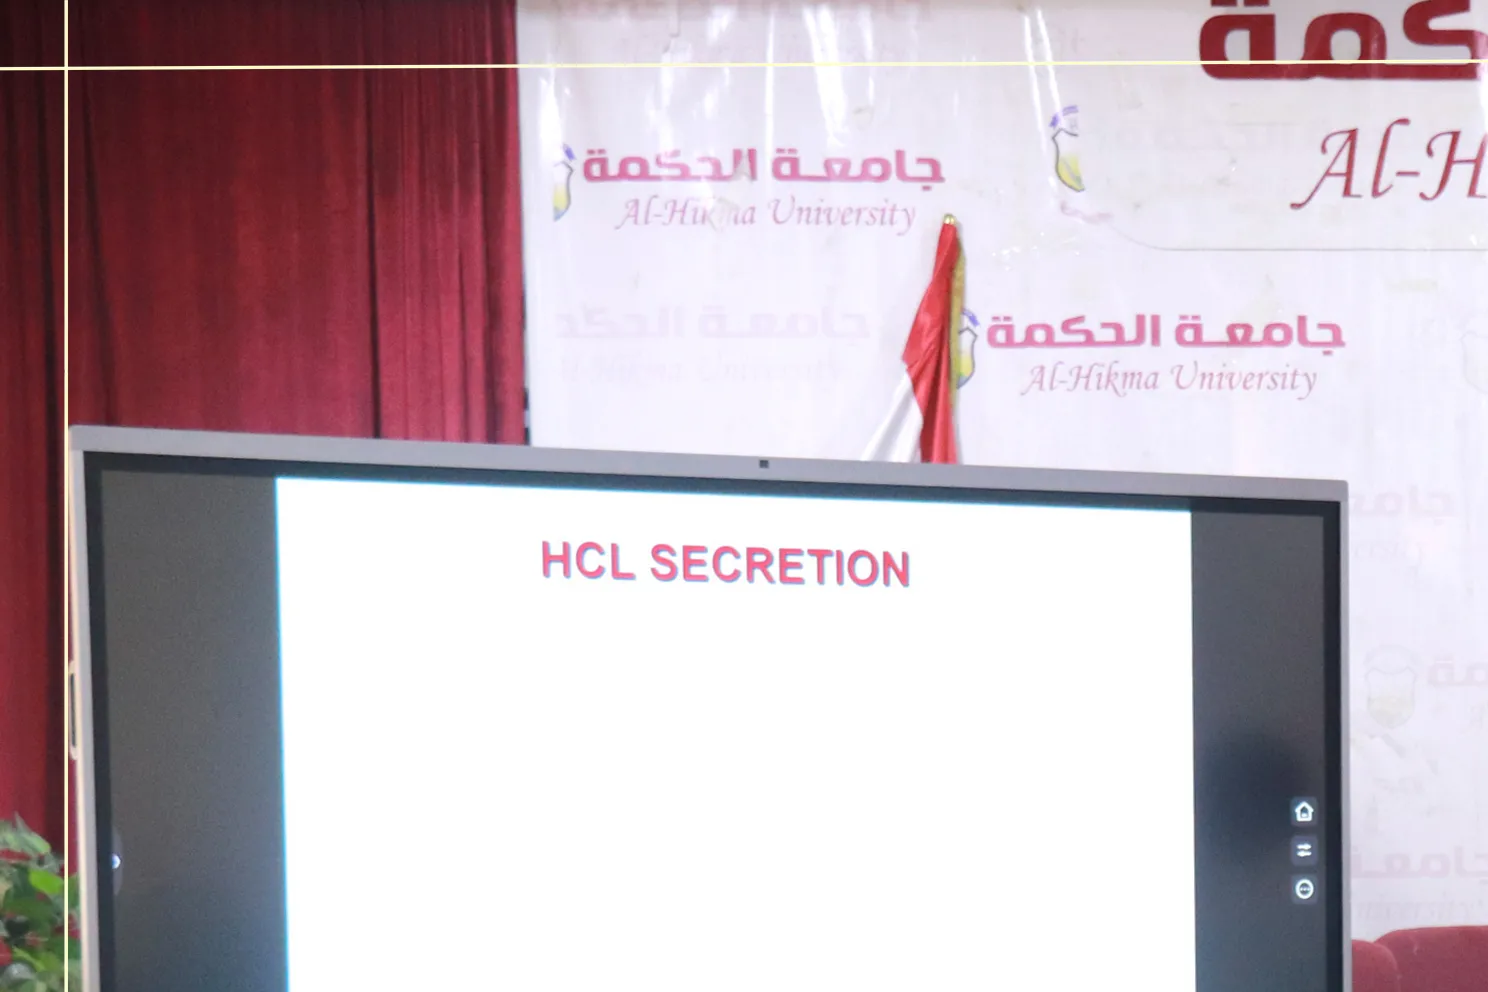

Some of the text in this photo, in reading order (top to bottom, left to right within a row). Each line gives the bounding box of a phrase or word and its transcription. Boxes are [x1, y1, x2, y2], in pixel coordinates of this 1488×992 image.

[581, 146, 946, 192] جامعة الحكمة
[771, 194, 916, 237] University
[986, 312, 1347, 357] جامعة الحكمة
[1019, 359, 1318, 402] Al-Hikma University
[541, 540, 910, 588] HCL SECRETION
